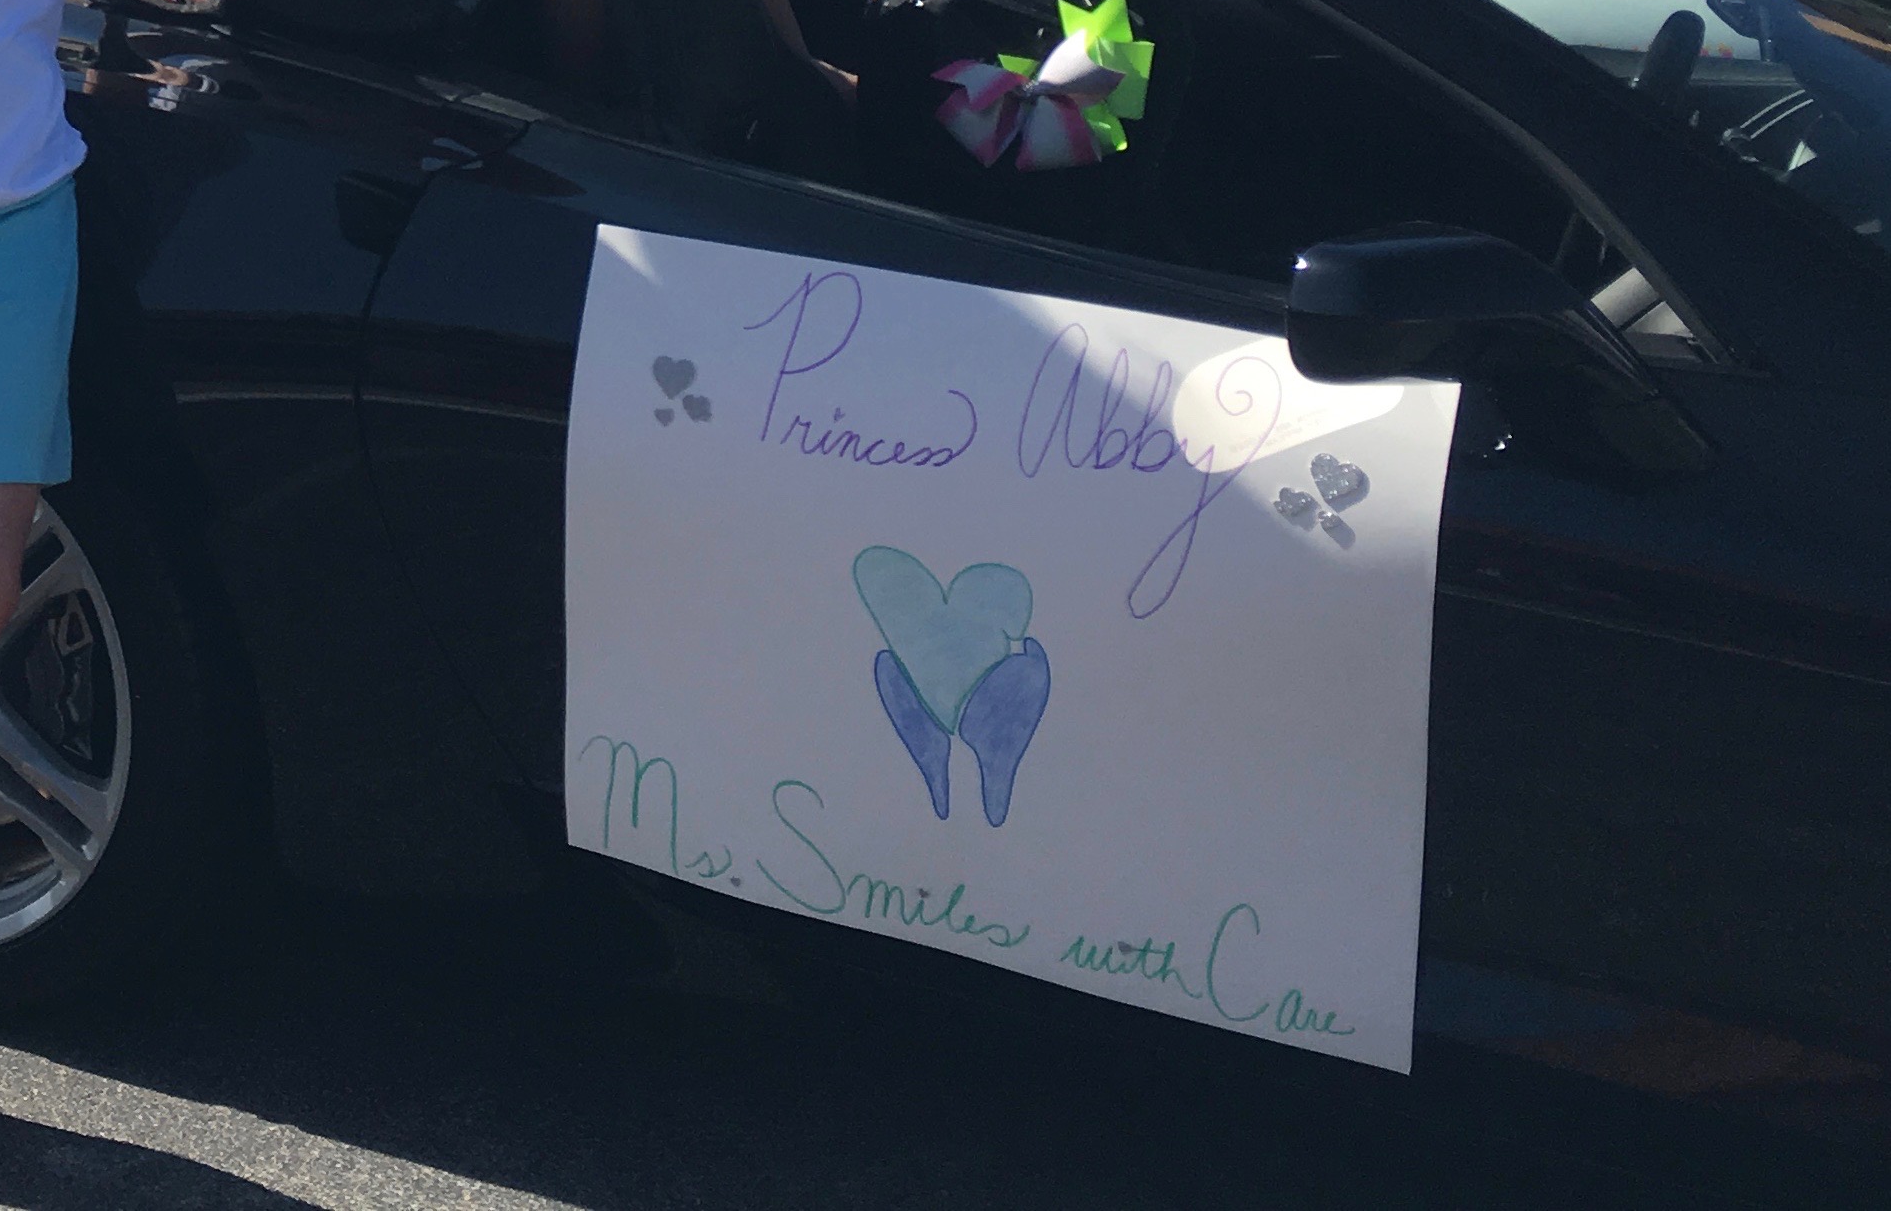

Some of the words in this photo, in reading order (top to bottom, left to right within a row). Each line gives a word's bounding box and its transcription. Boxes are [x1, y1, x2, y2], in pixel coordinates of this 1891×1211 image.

[744, 272, 978, 467] Princess
[1018, 323, 1282, 619] Abby
[756, 780, 1031, 948] Smiles
[1059, 936, 1203, 999] with
[1206, 903, 1356, 1036] Care
